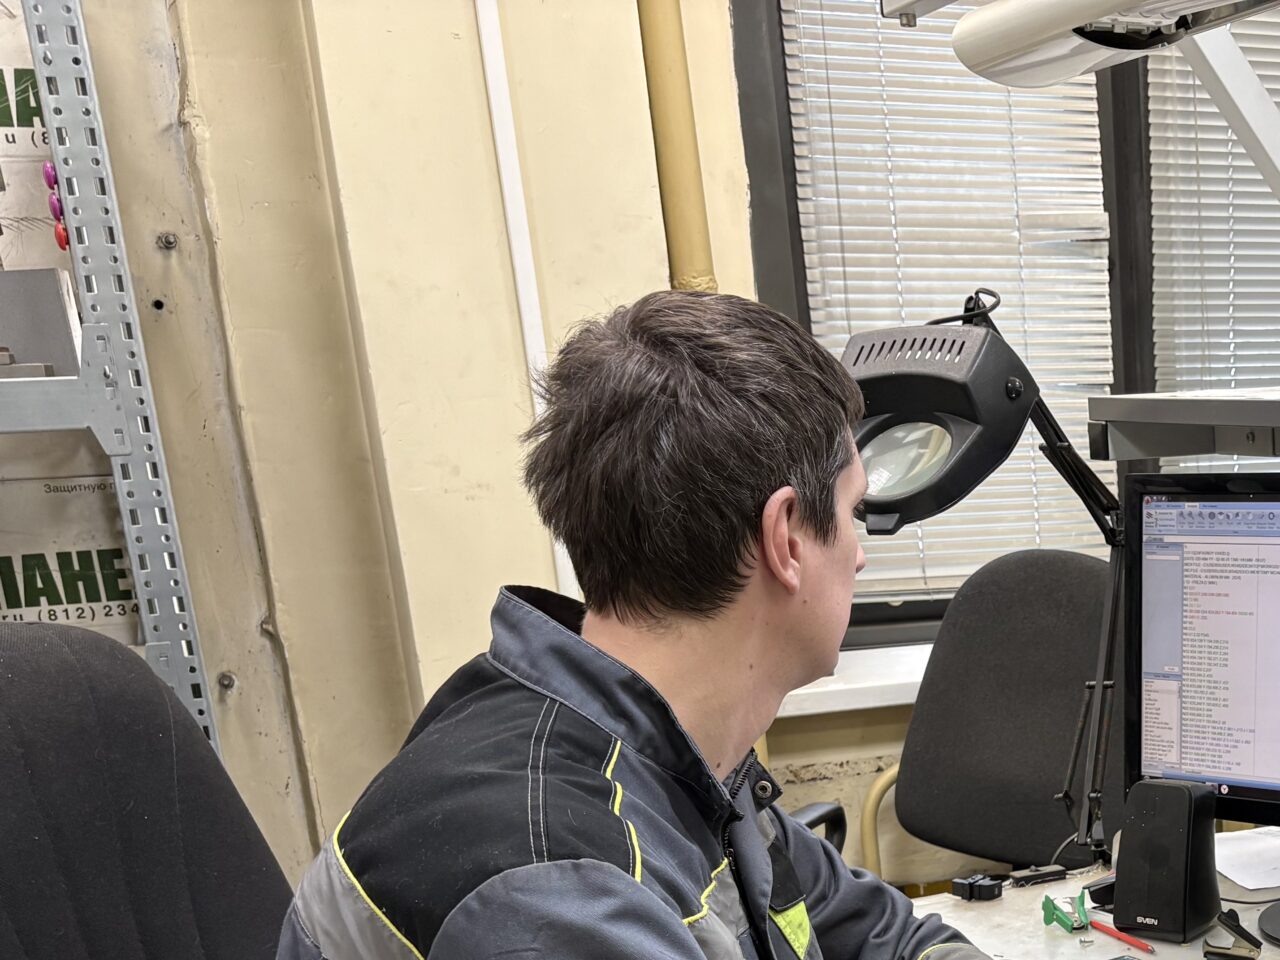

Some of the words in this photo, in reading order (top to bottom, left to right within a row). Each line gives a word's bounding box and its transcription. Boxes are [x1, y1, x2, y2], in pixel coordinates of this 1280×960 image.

[43, 482, 106, 494] Защитную
[38, 605, 96, 622] (812)
[1136, 916, 1158, 926] SVEN
